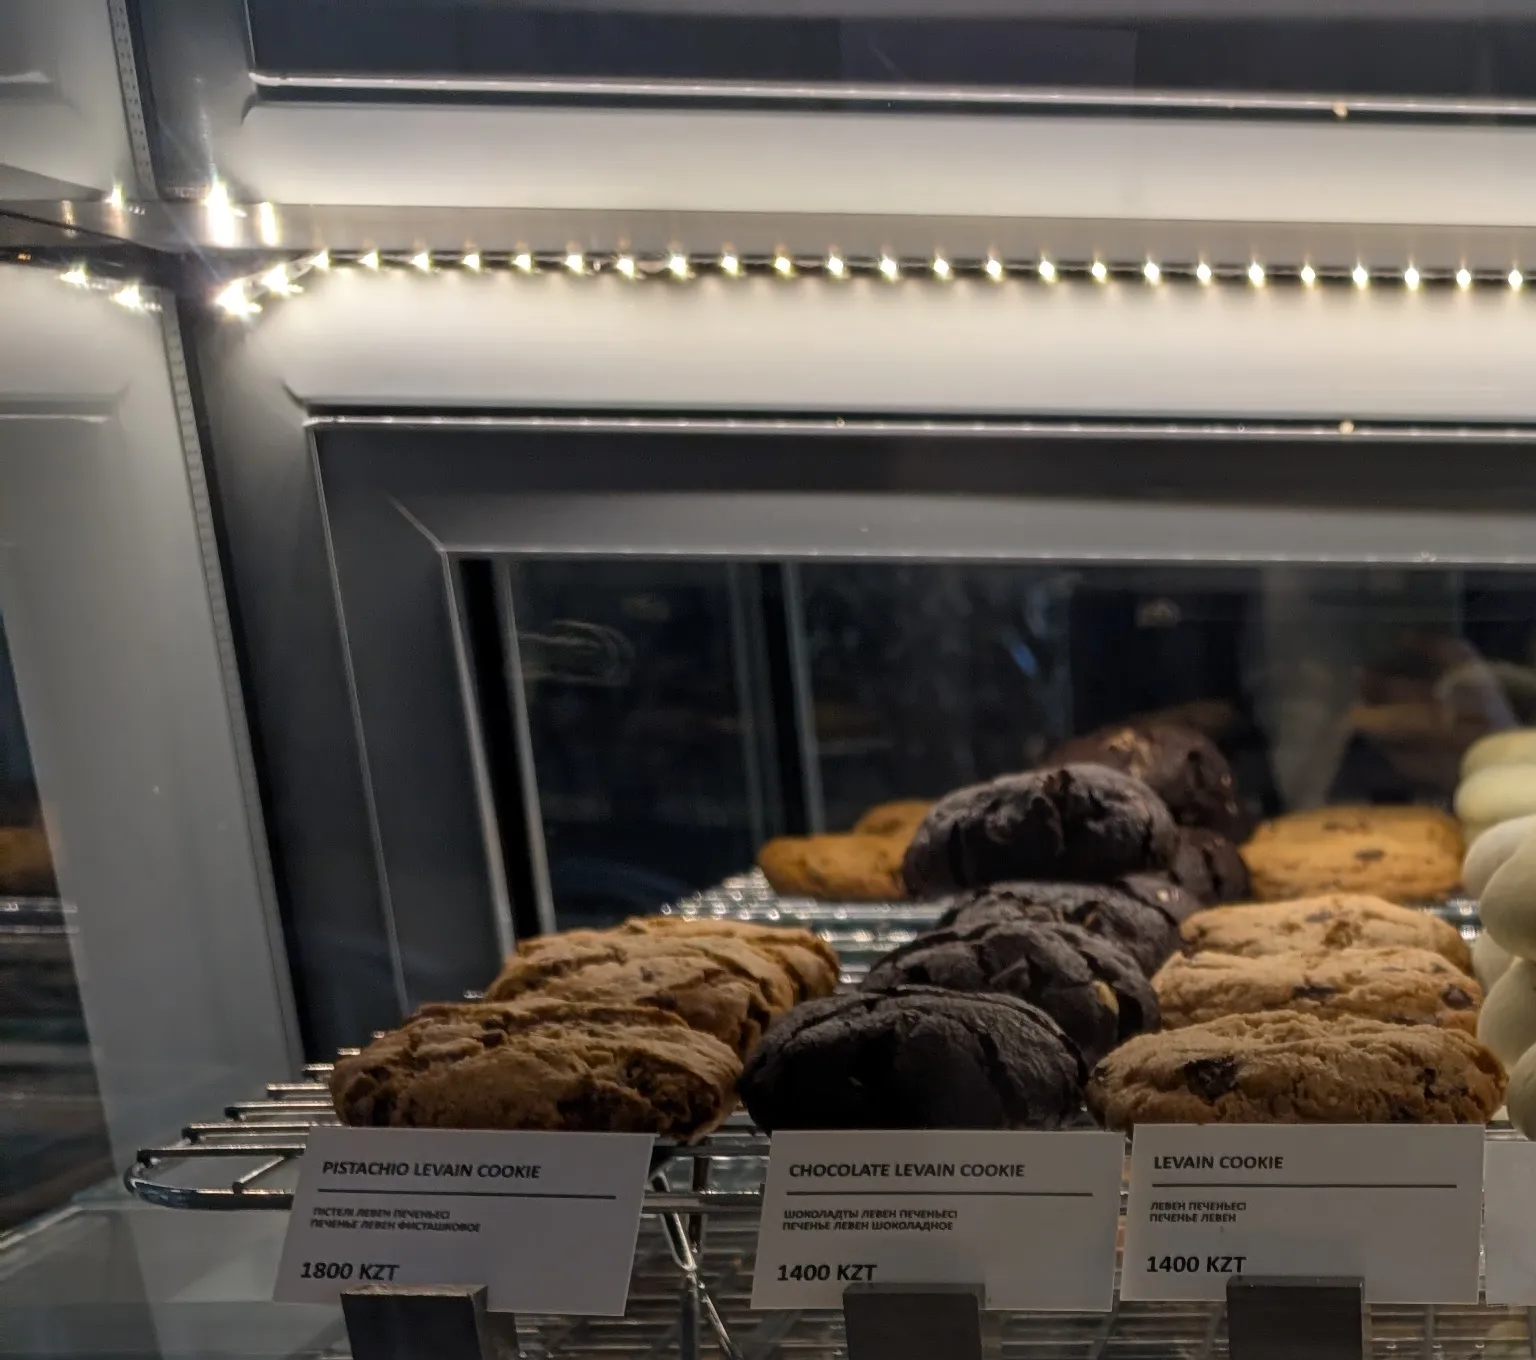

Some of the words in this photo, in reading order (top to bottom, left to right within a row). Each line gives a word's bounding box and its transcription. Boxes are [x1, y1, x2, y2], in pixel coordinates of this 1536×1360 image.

[1154, 1156, 1214, 1169] LEVAIN
[1219, 1156, 1284, 1169] COOKIE
[322, 1161, 409, 1176] PISTACHIO
[415, 1163, 471, 1178] LEVAIN
[478, 1165, 542, 1179] COOKIE
[789, 1164, 890, 1177] CHOCOLATE
[895, 1164, 955, 1177] LEVAIN
[960, 1164, 1025, 1178] COOKIE
[1150, 1202, 1186, 1211] ЛЕВЕН
[861, 1209, 896, 1219] ЛЕВЕН
[1149, 1213, 1198, 1223] ПЕЧЕНЬЕ
[1201, 1213, 1236, 1223] ЛЕВЕН
[782, 1221, 830, 1231] ПЕЧЕНЬЕ
[833, 1221, 870, 1231] ЛЕВЕН
[872, 1221, 953, 1232] ШОКОЛАДНОЕ
[1147, 1256, 1200, 1273] 1400
[1206, 1256, 1247, 1273] KZT
[300, 1262, 353, 1280] 1800
[359, 1264, 400, 1281] KZT
[777, 1265, 830, 1281] 1400
[837, 1264, 877, 1281] KZT
